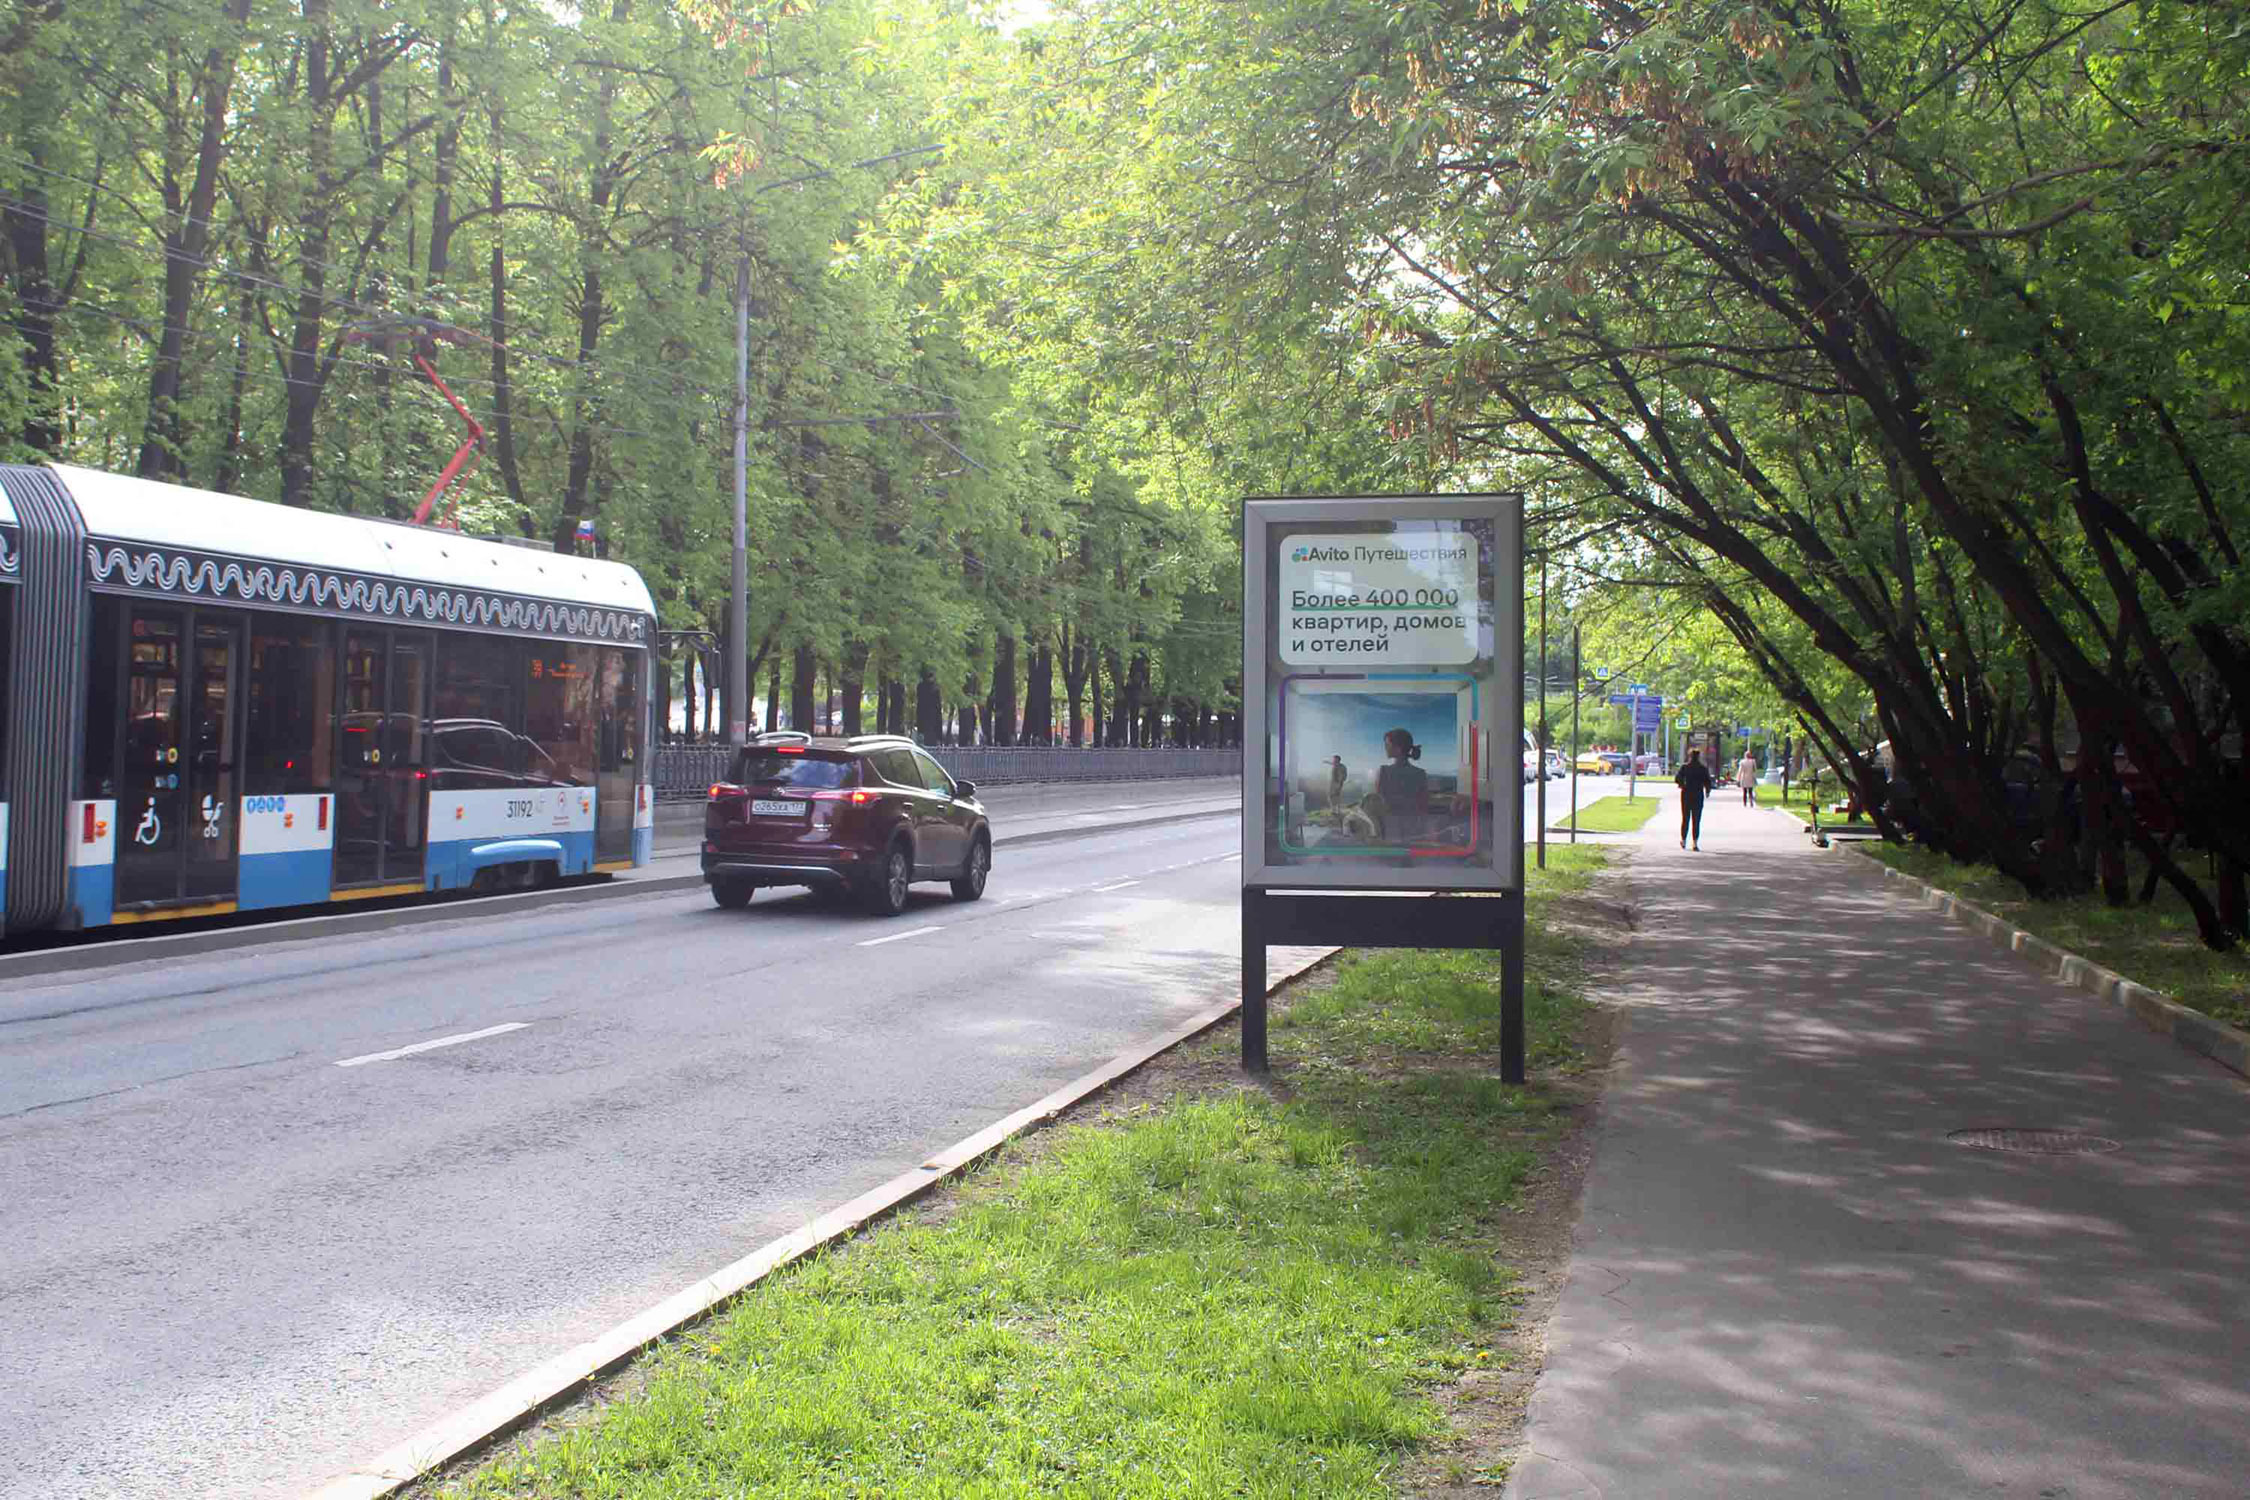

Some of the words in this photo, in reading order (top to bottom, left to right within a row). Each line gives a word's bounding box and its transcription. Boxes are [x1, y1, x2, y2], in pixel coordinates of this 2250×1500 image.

[1309, 547, 1350, 561] Avito
[1354, 546, 1467, 564] Путешествия
[1292, 591, 1359, 607] Более
[1366, 589, 1408, 606] 400
[1415, 588, 1459, 606] 000
[1292, 616, 1388, 633] квартир,
[1292, 640, 1305, 651] и
[1310, 634, 1389, 652] отелей
[507, 801, 533, 818] 31192
